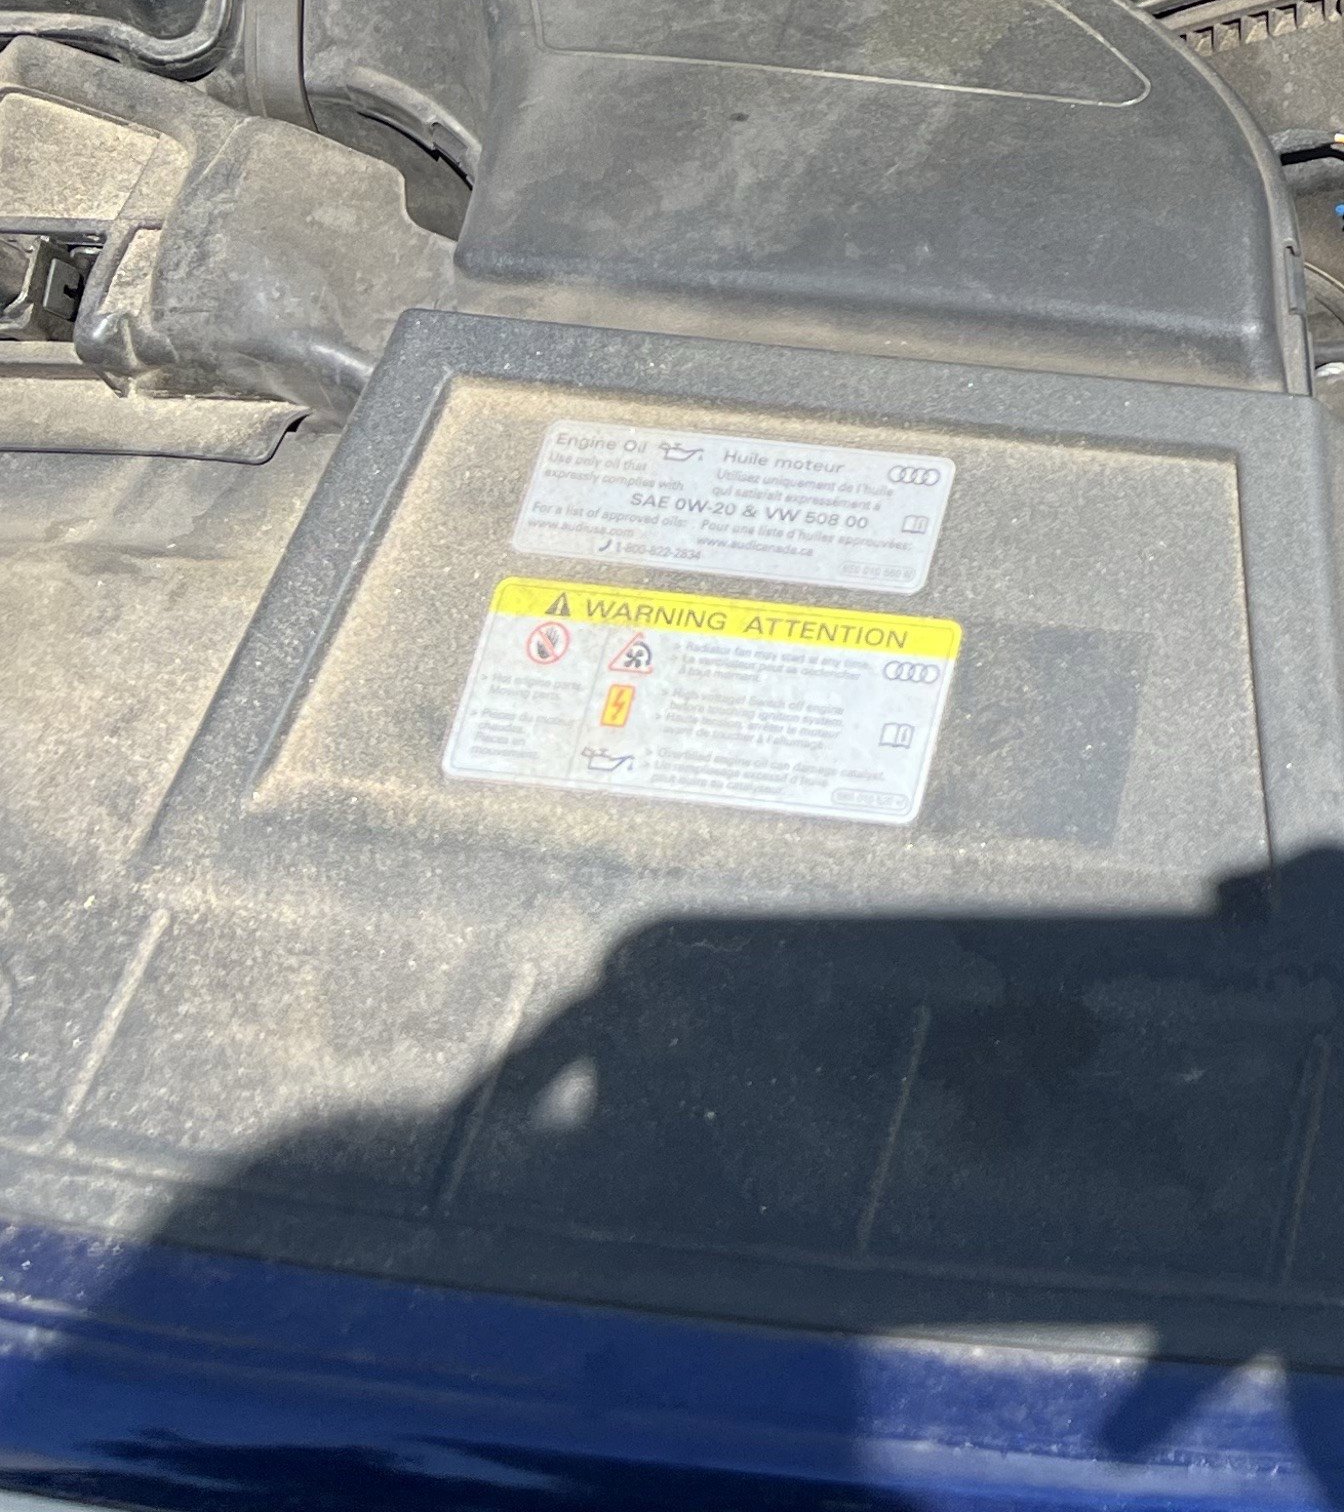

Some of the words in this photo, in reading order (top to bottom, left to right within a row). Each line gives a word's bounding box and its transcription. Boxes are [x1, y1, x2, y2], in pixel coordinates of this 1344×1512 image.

[556, 433, 617, 451] Engine
[623, 439, 646, 453] Oil
[547, 452, 572, 464] Use
[575, 455, 601, 469] only
[605, 458, 620, 470] oil
[623, 460, 647, 471] that
[723, 449, 769, 466] Huile
[774, 456, 845, 474] moteur
[544, 469, 600, 484] expressly
[601, 474, 655, 489] complies
[658, 480, 684, 492] with
[532, 501, 553, 514] For
[566, 505, 584, 517] list
[587, 507, 600, 519] of
[601, 511, 658, 526] approved
[630, 492, 670, 509] SAE
[674, 497, 737, 517] 0W-20
[742, 505, 757, 518] &
[765, 506, 801, 522] VW
[804, 511, 839, 526] 508
[844, 515, 870, 529] 00
[700, 518, 729, 532] Pour
[731, 523, 755, 535] une
[757, 525, 784, 537] liste
[586, 598, 728, 631] WARNING
[742, 616, 909, 649] ATTENTION
